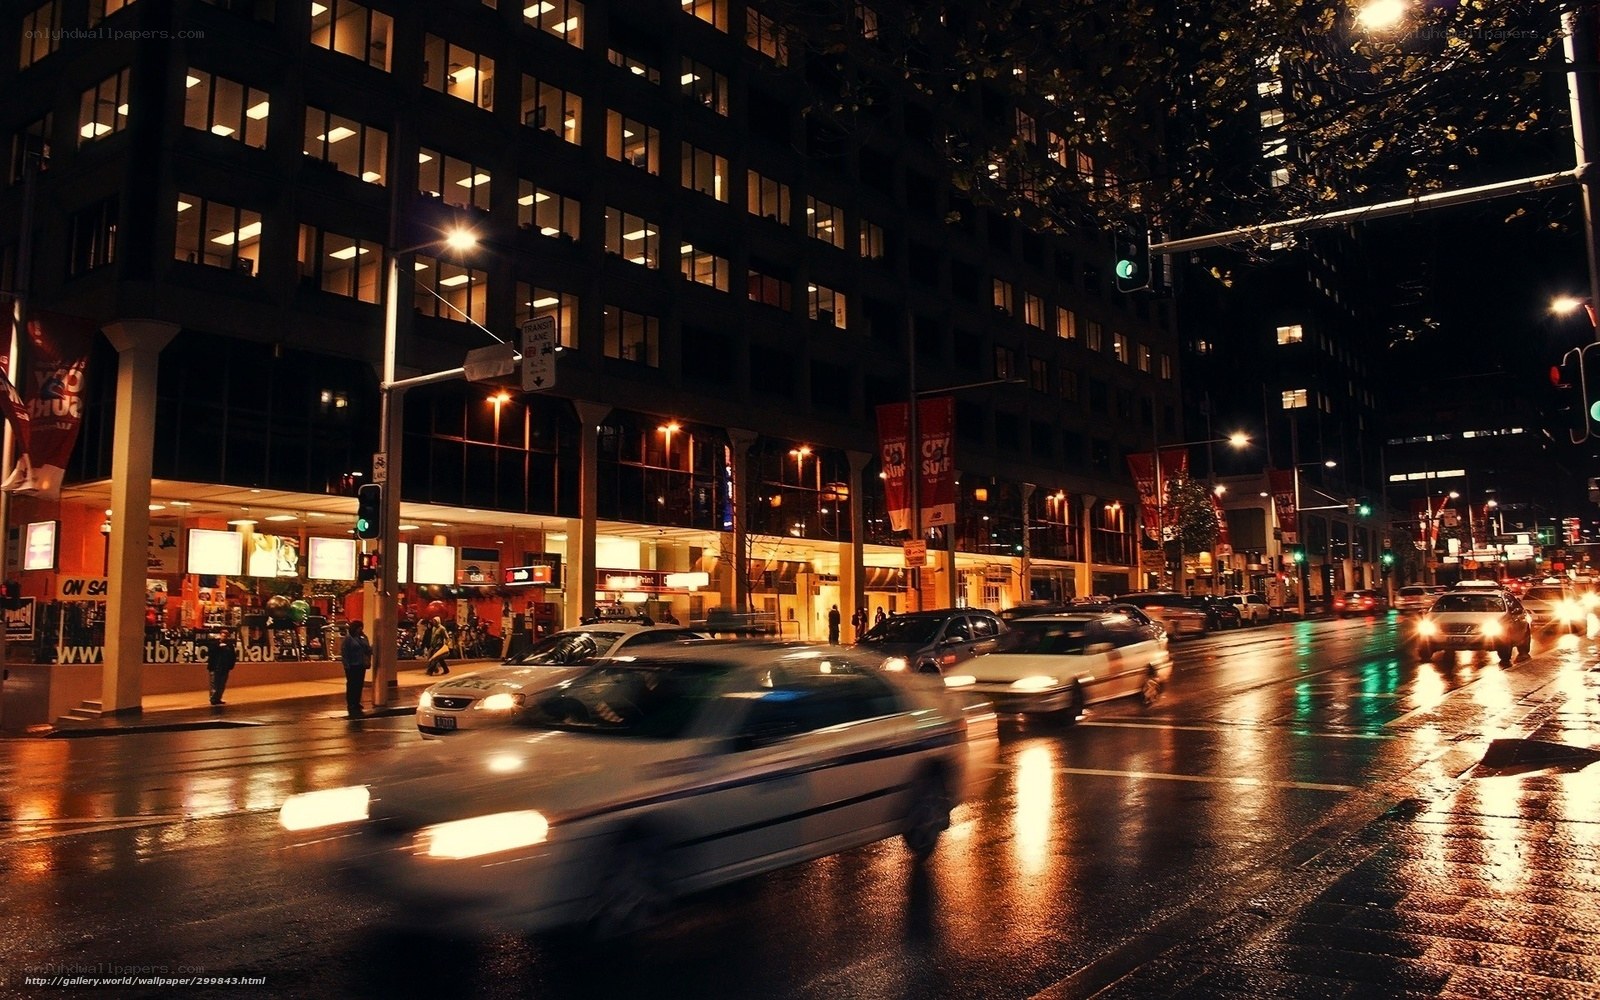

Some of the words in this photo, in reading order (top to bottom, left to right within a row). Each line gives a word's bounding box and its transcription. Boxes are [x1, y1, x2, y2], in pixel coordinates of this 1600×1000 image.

[529, 332, 548, 343] LANE
[63, 580, 85, 596] ON
[87, 580, 108, 596] SA
